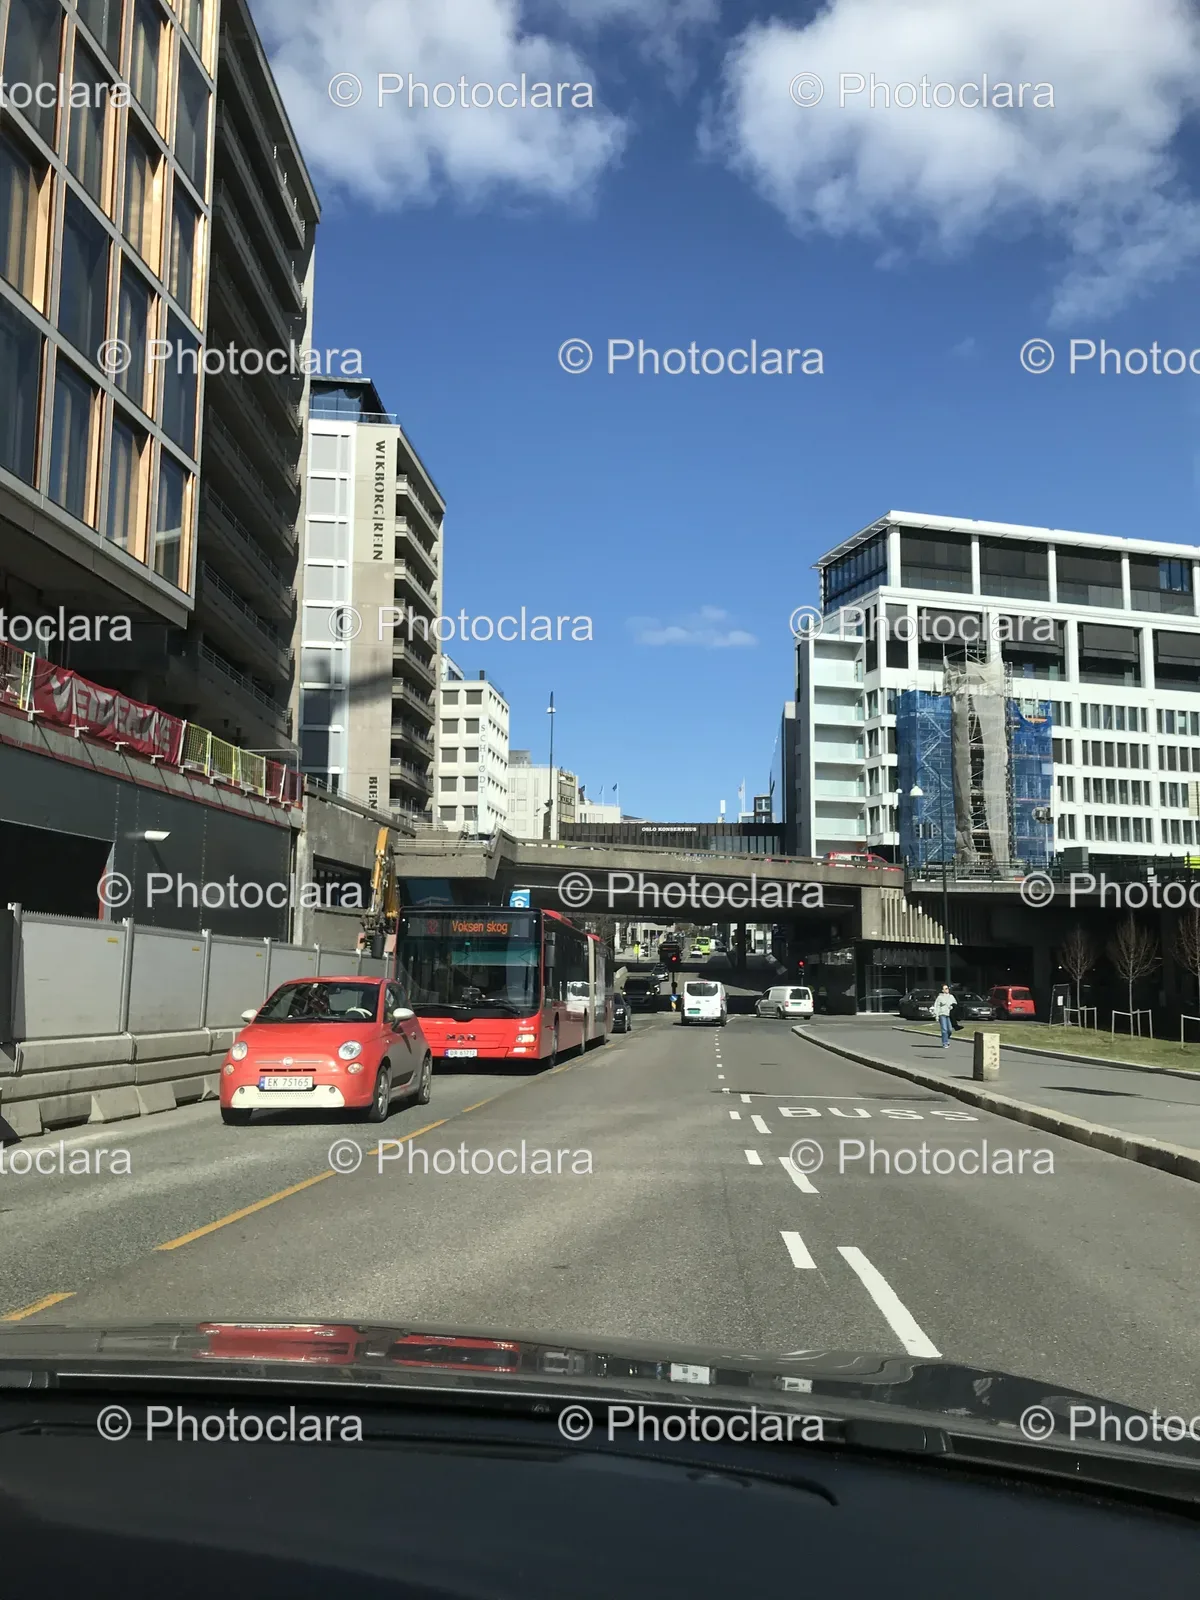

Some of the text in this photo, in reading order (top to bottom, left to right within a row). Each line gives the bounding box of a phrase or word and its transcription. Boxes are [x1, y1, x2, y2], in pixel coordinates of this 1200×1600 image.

[452, 920, 484, 932] Voksen
[486, 920, 508, 934] skog
[446, 1033, 476, 1041] MAN
[267, 1078, 309, 1087] EK 75165
[777, 1106, 979, 1121] BUSS
